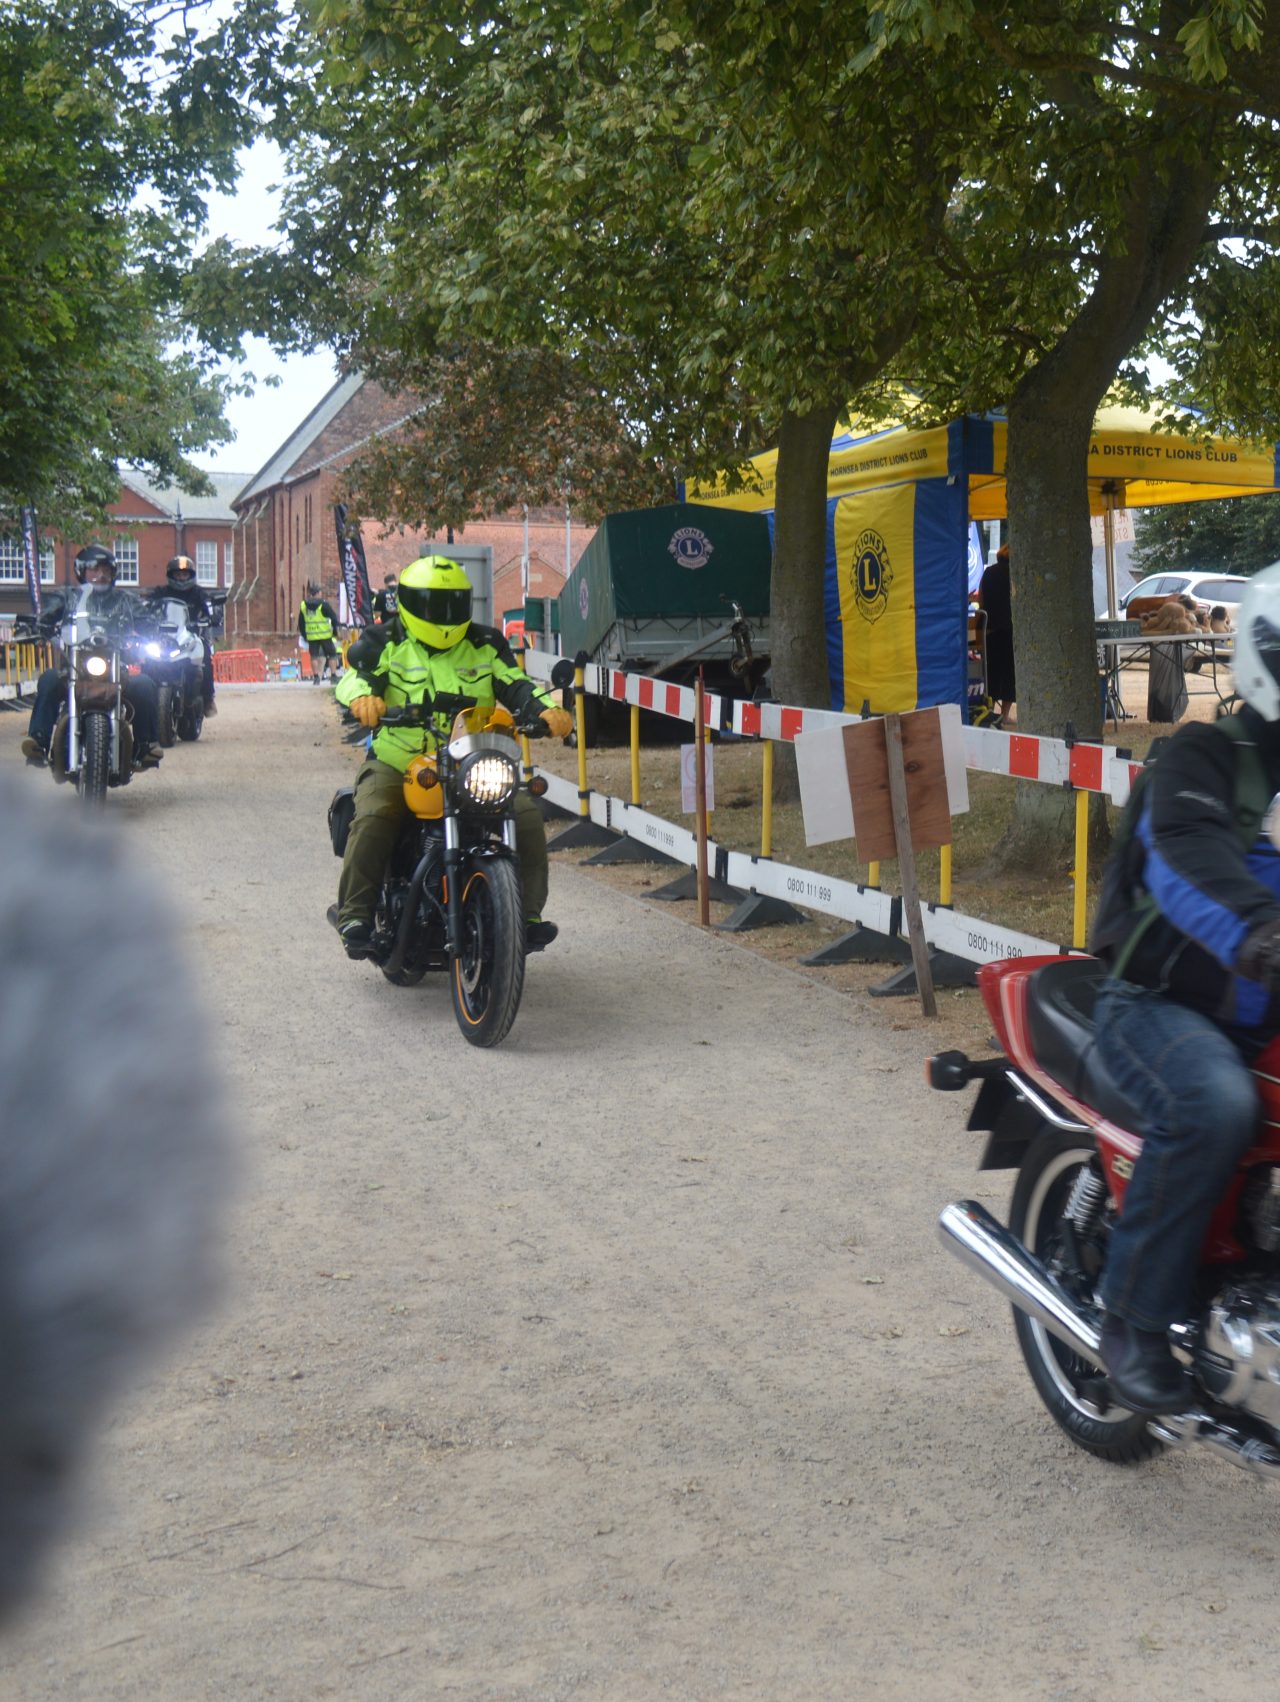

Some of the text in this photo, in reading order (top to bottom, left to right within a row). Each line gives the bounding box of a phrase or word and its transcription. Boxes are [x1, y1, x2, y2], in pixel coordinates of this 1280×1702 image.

[830, 448, 928, 477] HORNSEA DISTRICT LIONS CLUB
[1103, 444, 1161, 459] DISTRICT
[1165, 449, 1202, 461] LIONS
[1206, 451, 1238, 463] CLUB
[675, 528, 704, 539] LIONS
[857, 533, 881, 552] LIONS
[685, 540, 698, 555] L
[344, 543, 357, 612] HORNSEA
[863, 559, 876, 590] L
[787, 878, 831, 902] 0800 111 999
[968, 932, 987, 952] 0800
[990, 940, 1004, 957] 111
